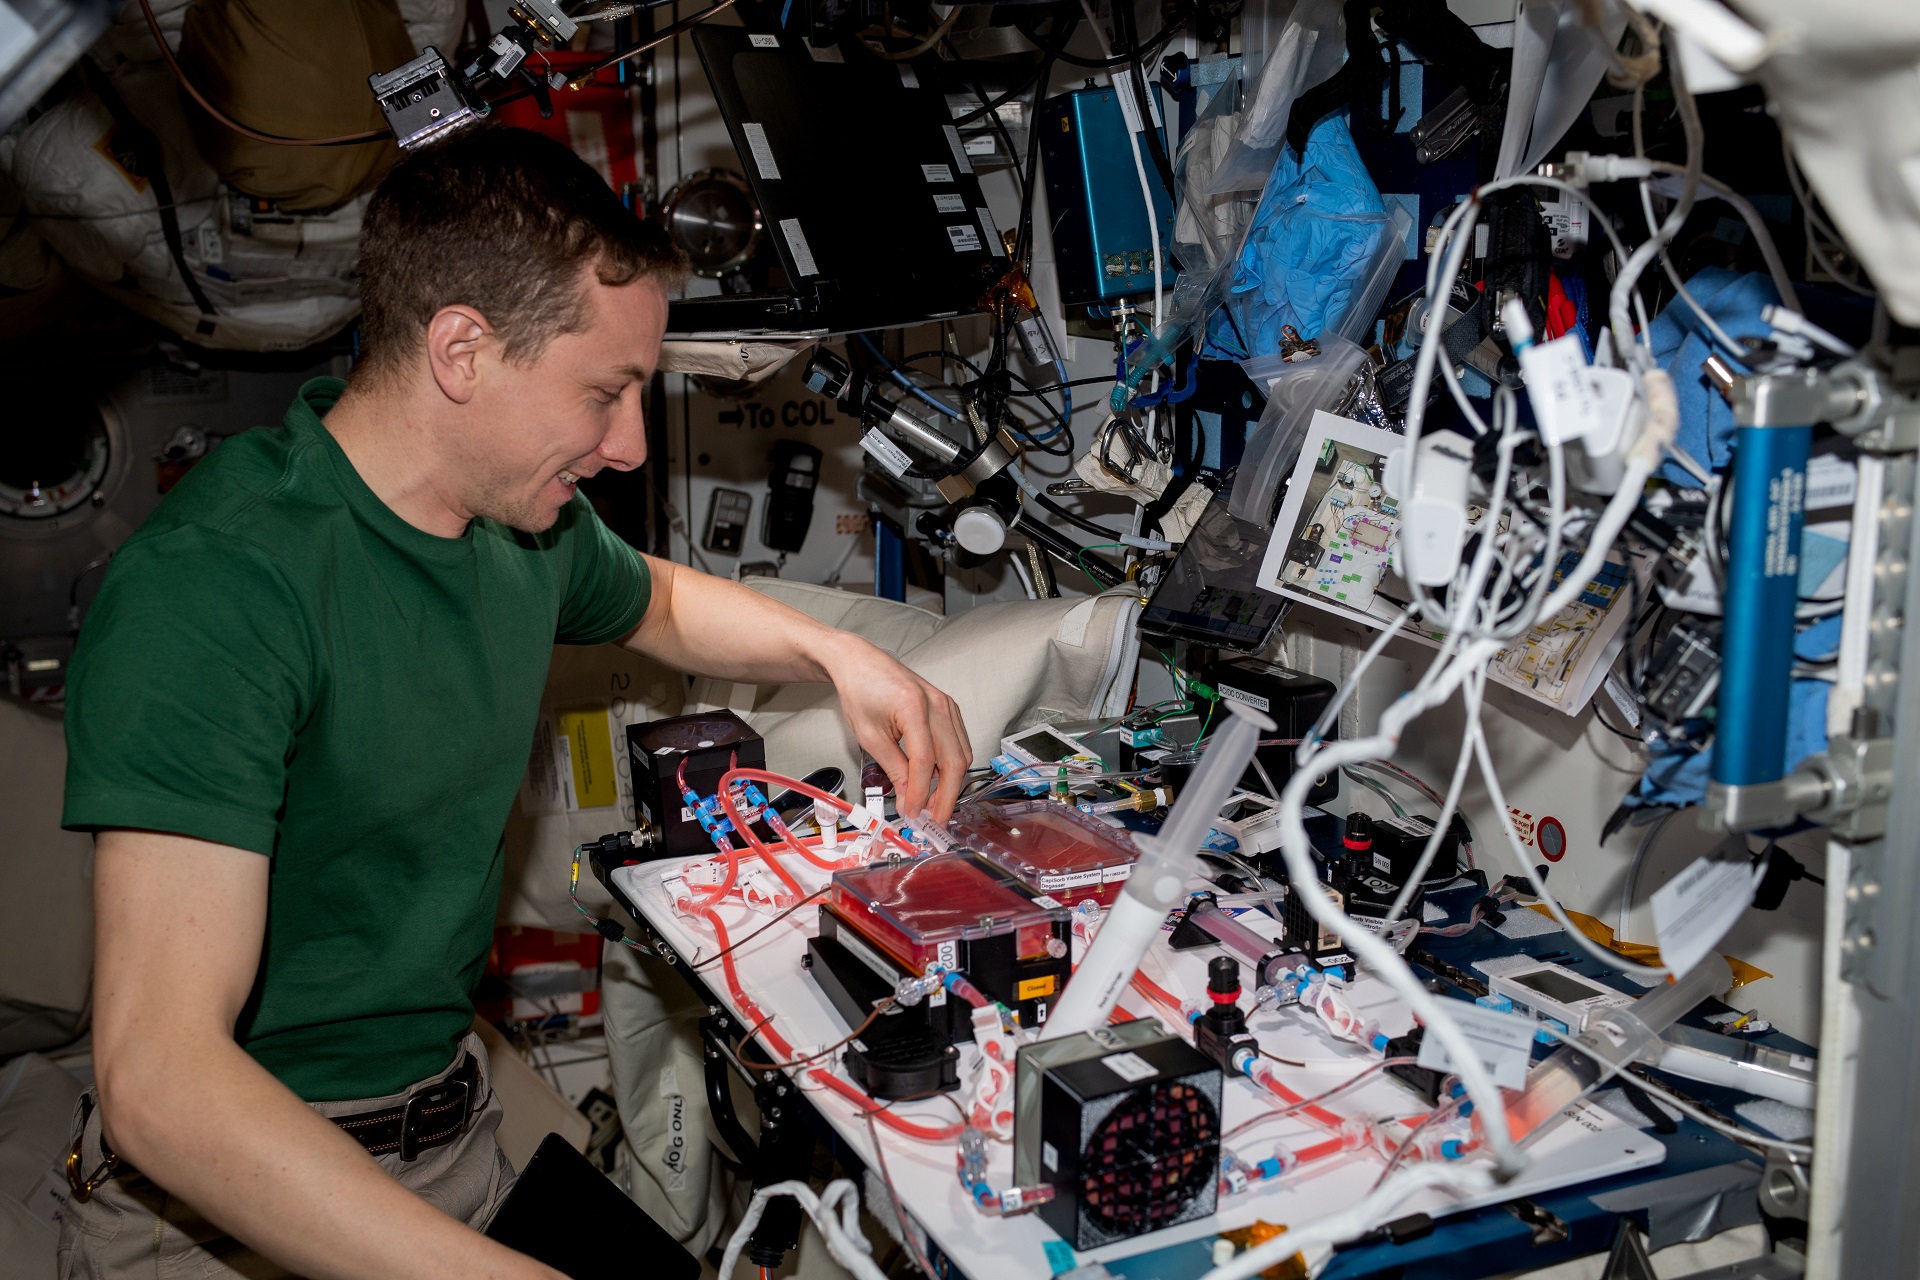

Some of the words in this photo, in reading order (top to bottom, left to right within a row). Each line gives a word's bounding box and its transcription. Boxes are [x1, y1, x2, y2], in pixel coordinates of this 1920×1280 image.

[744, 402, 775, 429] To
[781, 400, 835, 428] COL
[1219, 686, 1235, 698] AC/DC
[1235, 692, 1268, 709] CONVERTER
[1041, 876, 1066, 884] CapiSorb
[1083, 872, 1101, 880] System
[1369, 879, 1394, 890] ON
[1364, 917, 1383, 926] Visible
[1027, 983, 1046, 992] Closed
[1094, 1029, 1116, 1046] ON
[673, 1136, 684, 1148] G
